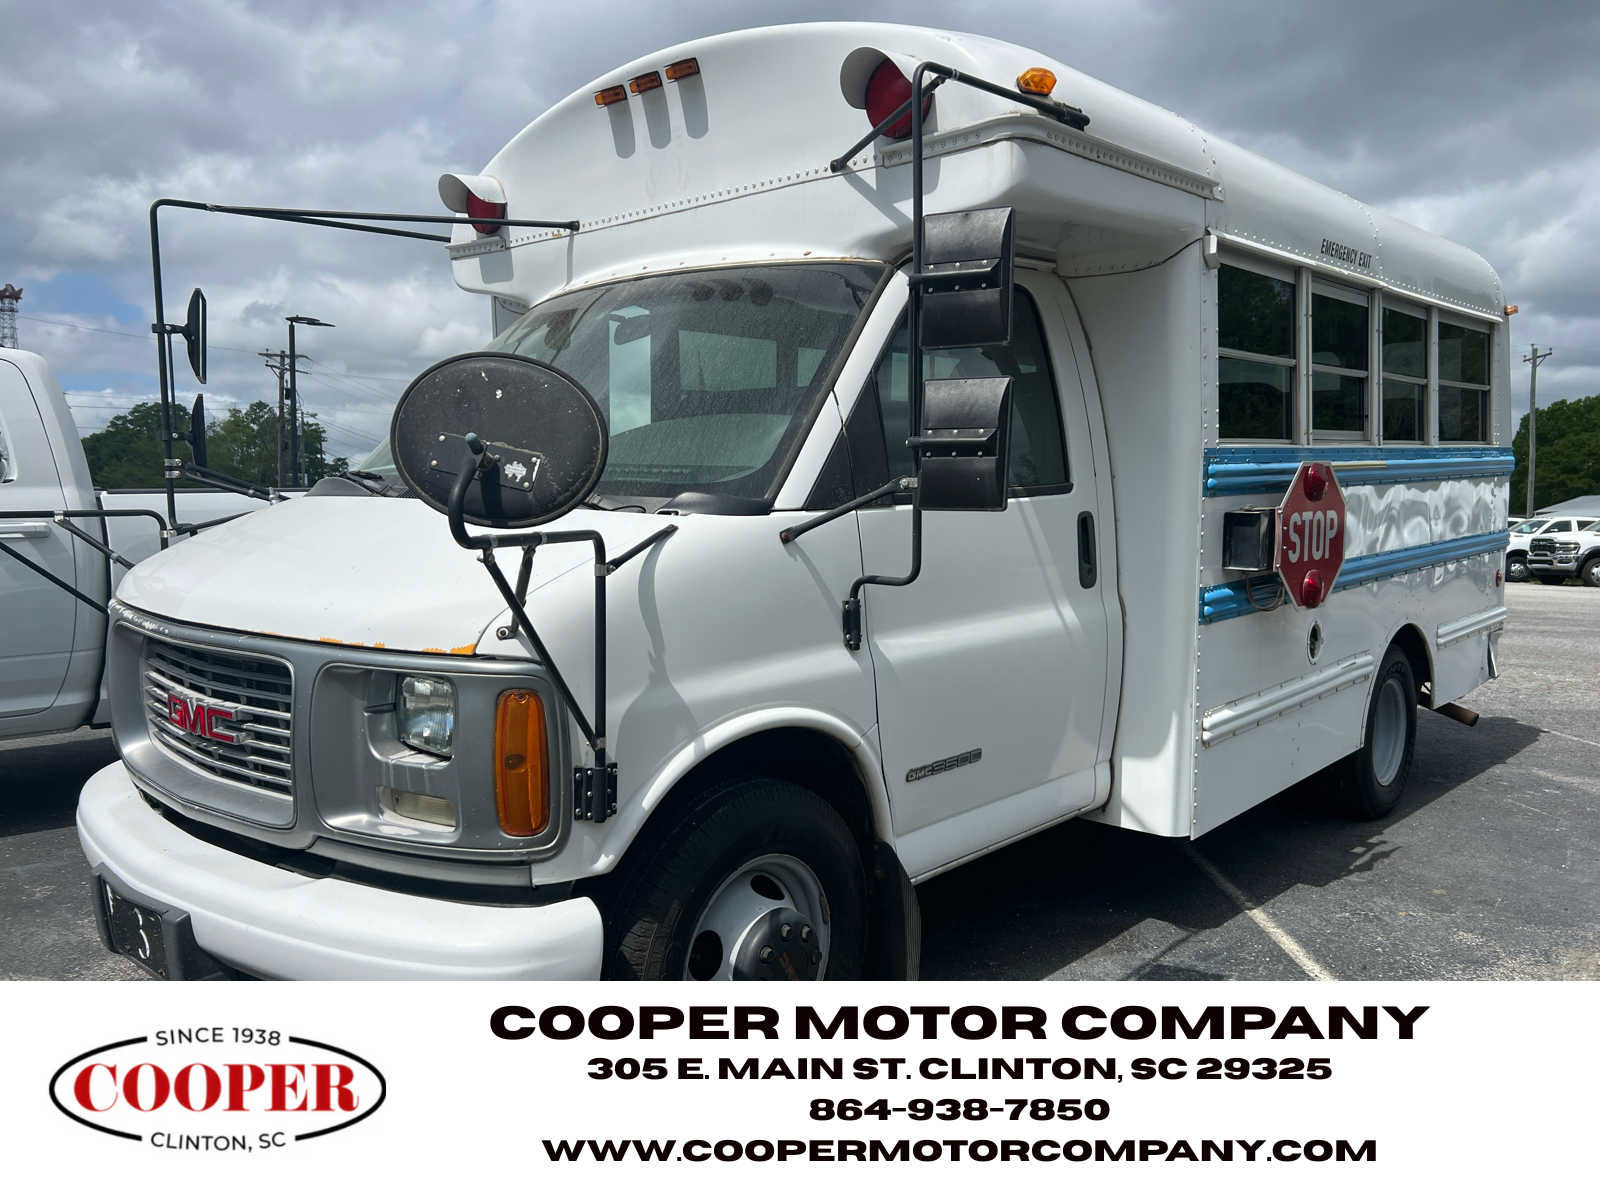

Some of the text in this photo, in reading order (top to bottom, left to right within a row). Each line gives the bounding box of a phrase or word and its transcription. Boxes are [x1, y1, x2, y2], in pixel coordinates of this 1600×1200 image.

[1320, 239, 1372, 268] EMERGENCY EXIT
[1288, 510, 1338, 563] STOP
[167, 692, 239, 745] GMC
